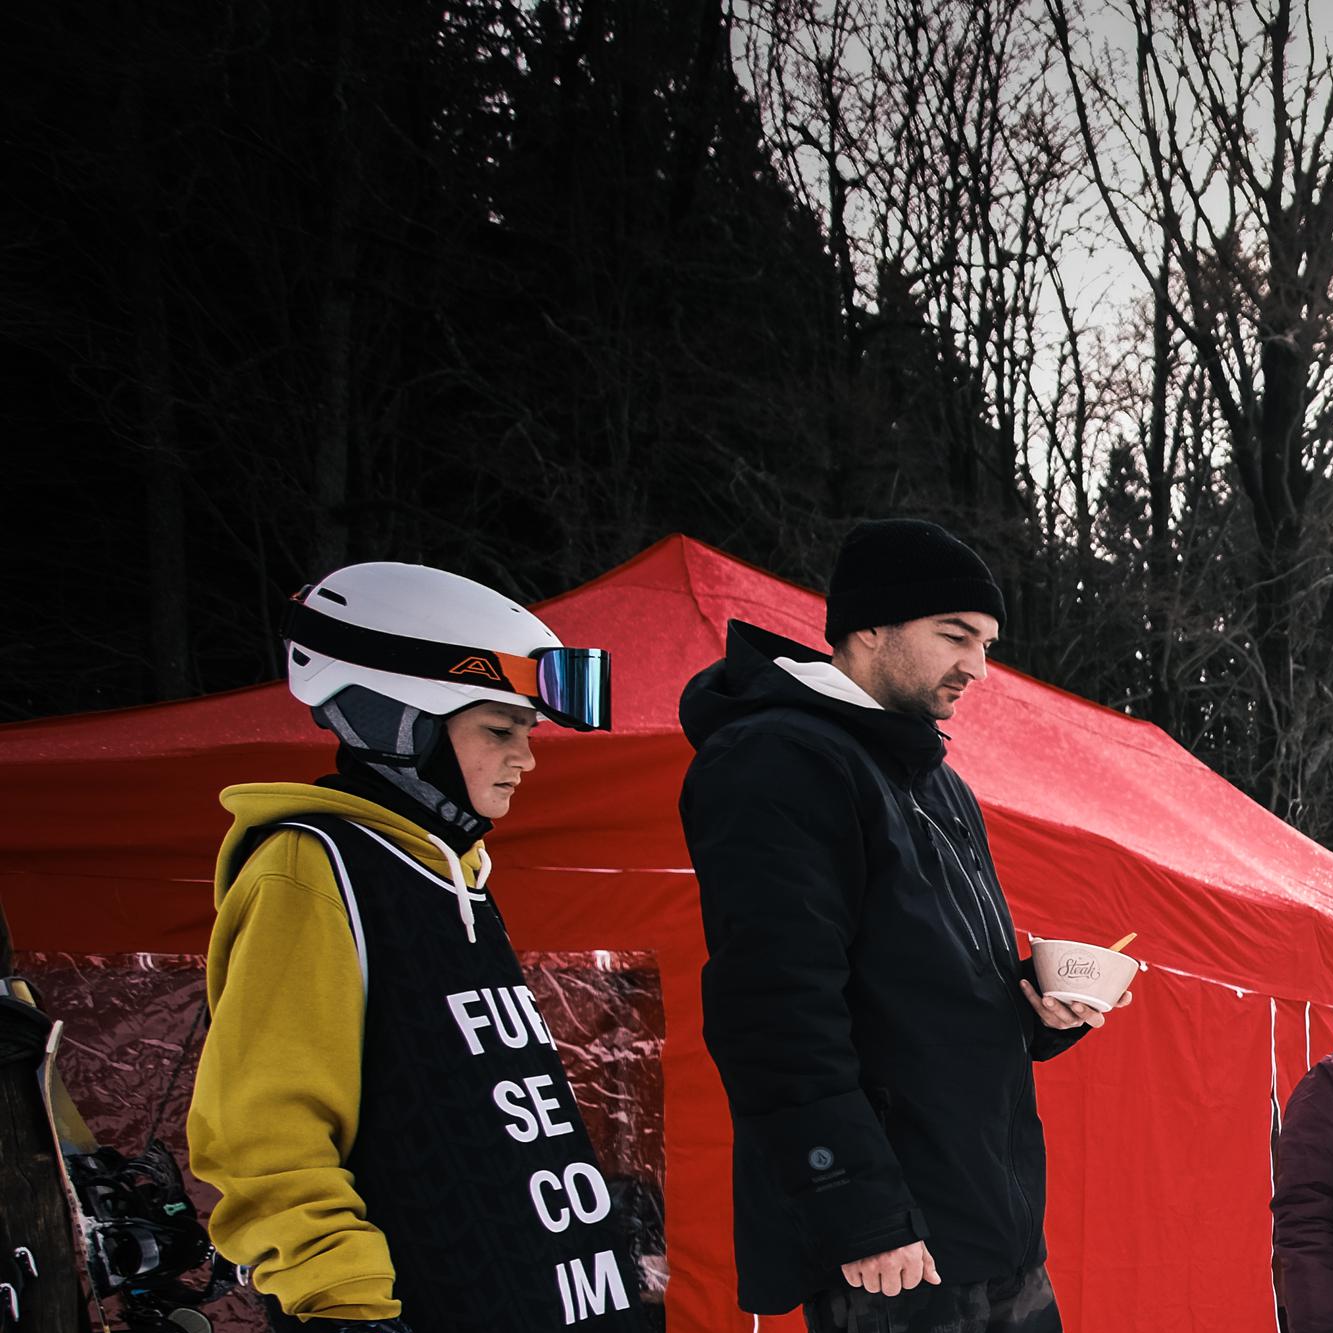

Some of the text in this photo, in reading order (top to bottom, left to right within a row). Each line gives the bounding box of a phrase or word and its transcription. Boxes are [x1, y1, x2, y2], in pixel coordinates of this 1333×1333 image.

[492, 1074, 575, 1143] SE
[529, 1161, 612, 1233] CO
[554, 1249, 631, 1326] IM
